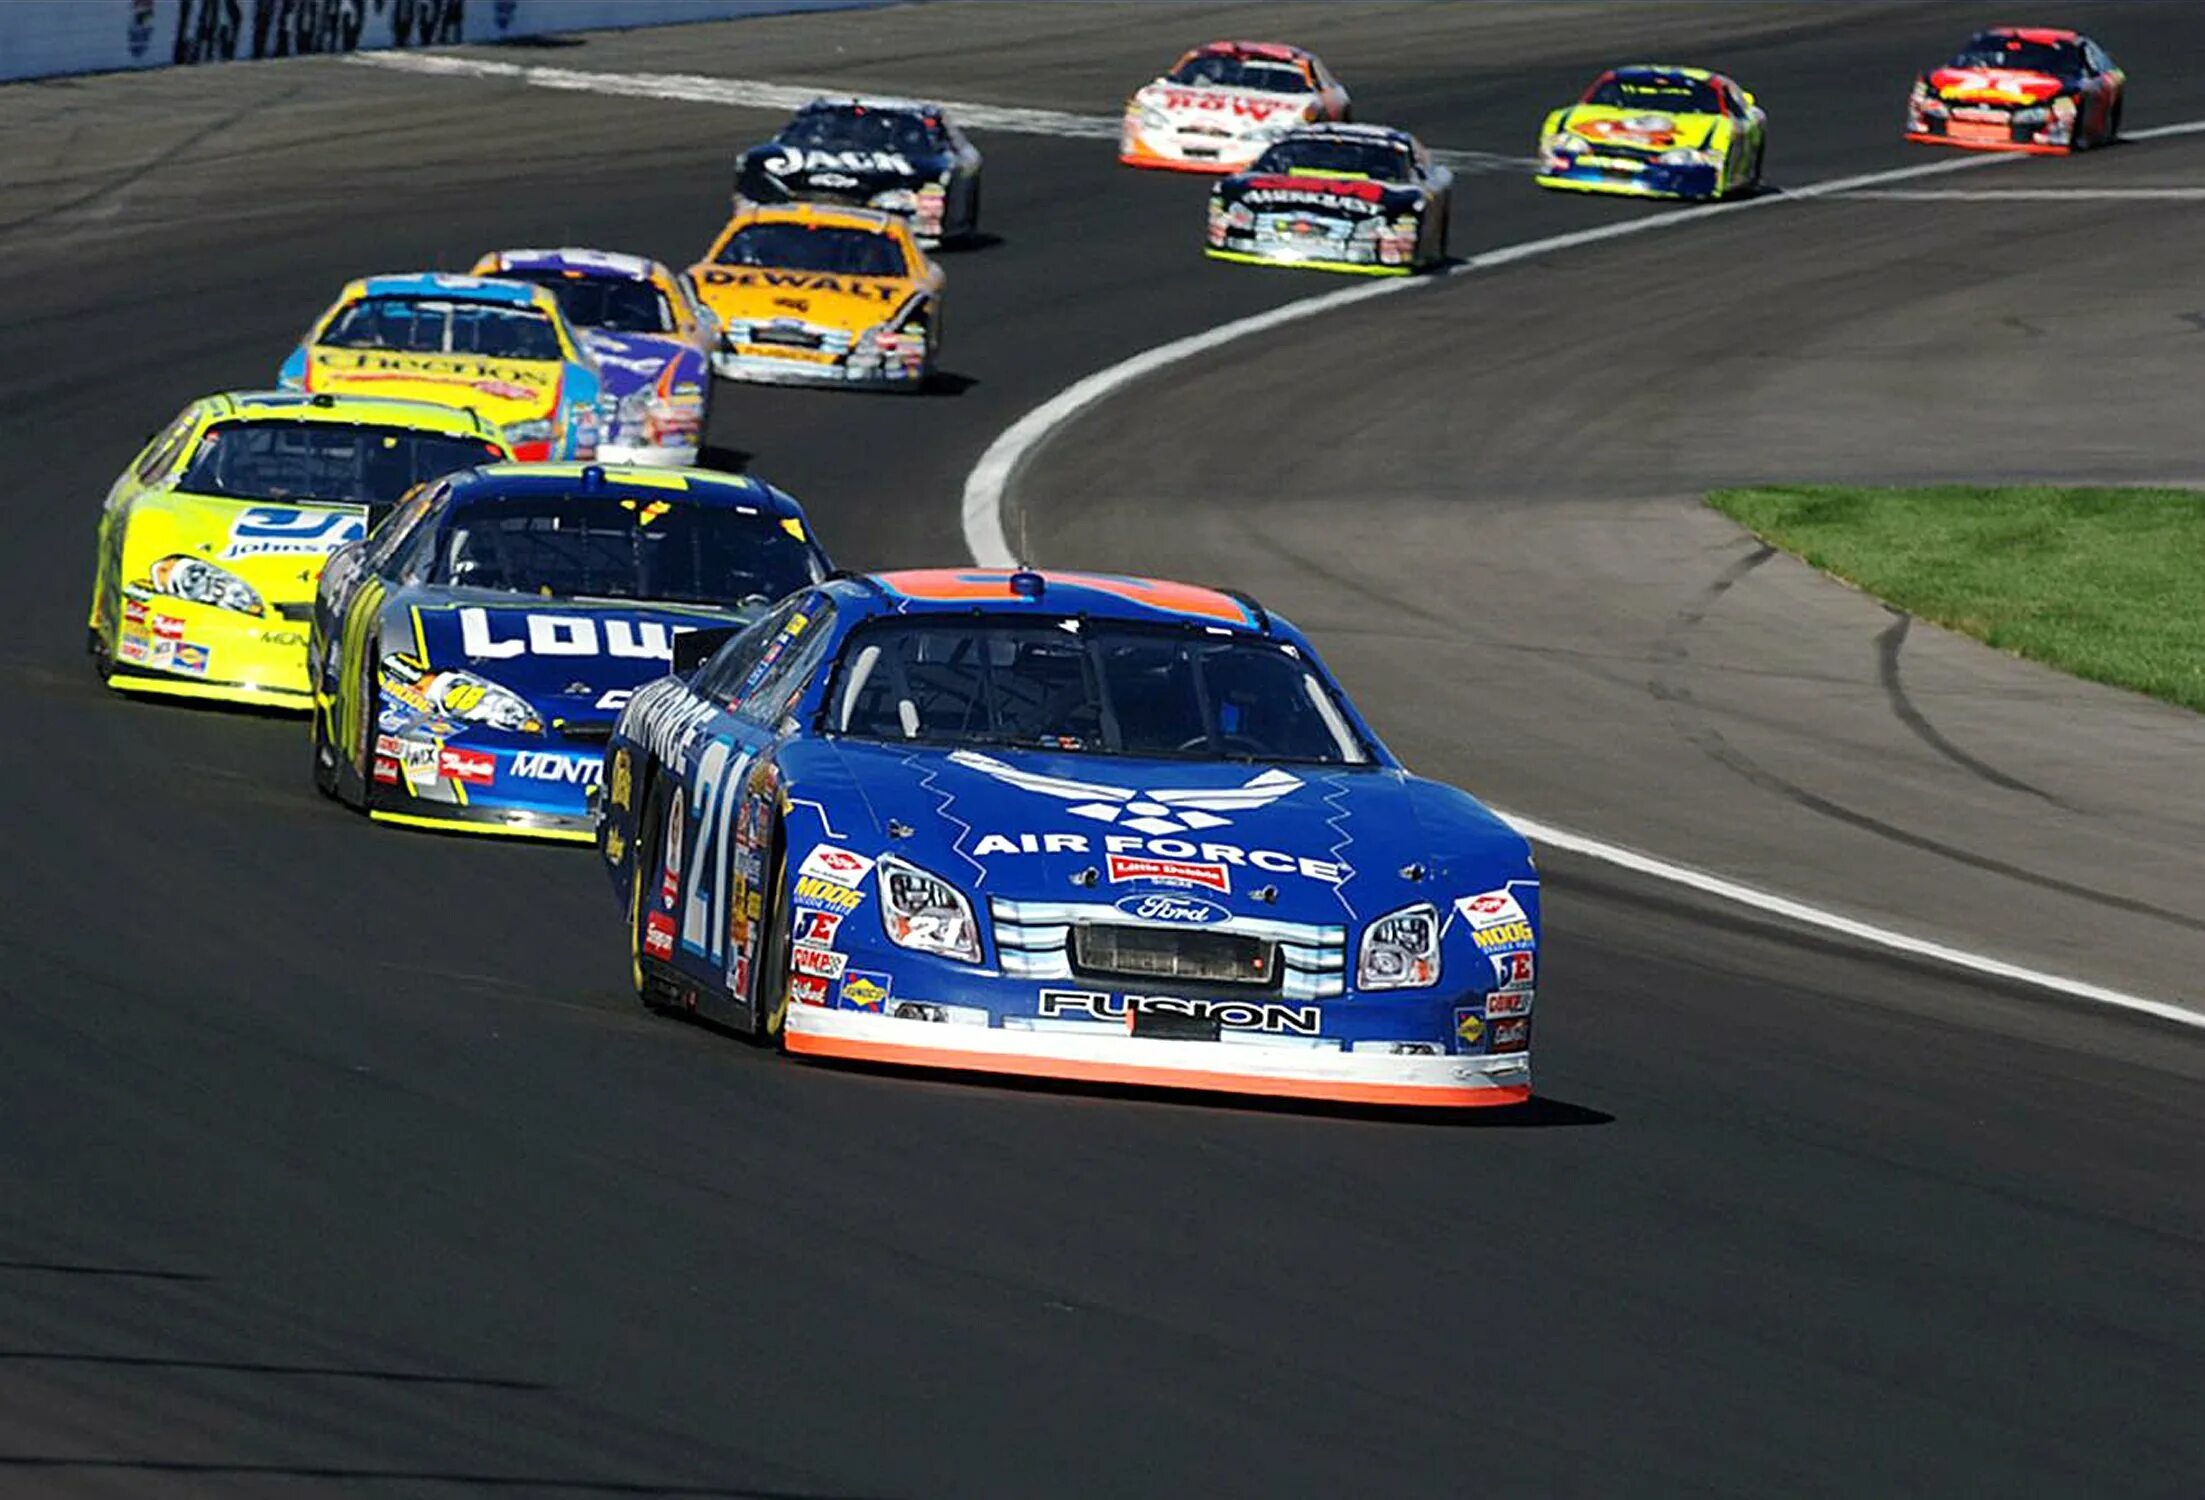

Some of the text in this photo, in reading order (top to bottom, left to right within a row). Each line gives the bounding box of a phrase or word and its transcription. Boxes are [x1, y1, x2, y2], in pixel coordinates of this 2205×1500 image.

[443, 683, 487, 711] 48
[973, 833, 1344, 883] AIR FORCE
[794, 876, 867, 909] MOOG
[1137, 896, 1210, 923] Ford
[901, 917, 964, 950] 21
[1471, 921, 1534, 951] MOOG
